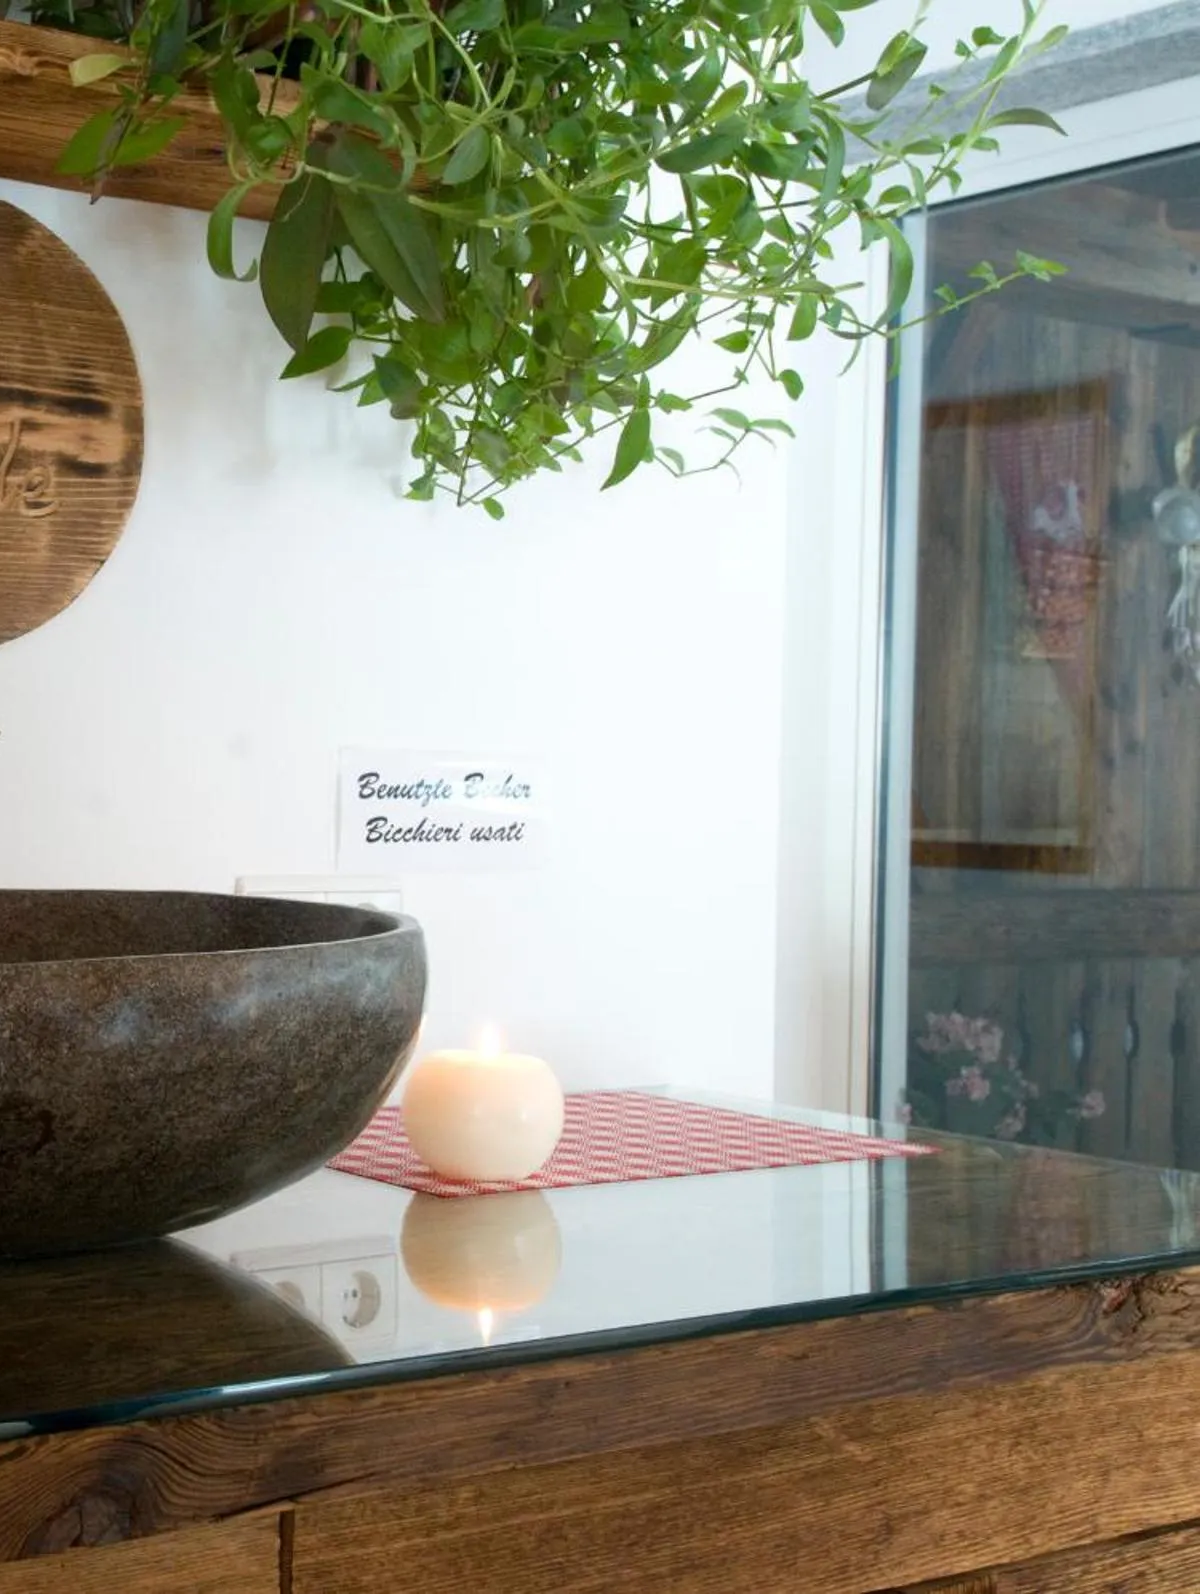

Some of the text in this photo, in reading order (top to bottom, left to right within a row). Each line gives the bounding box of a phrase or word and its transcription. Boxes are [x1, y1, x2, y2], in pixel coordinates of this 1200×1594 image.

[463, 772, 532, 799] Bcher
[366, 816, 525, 843] Bicchieri usati
